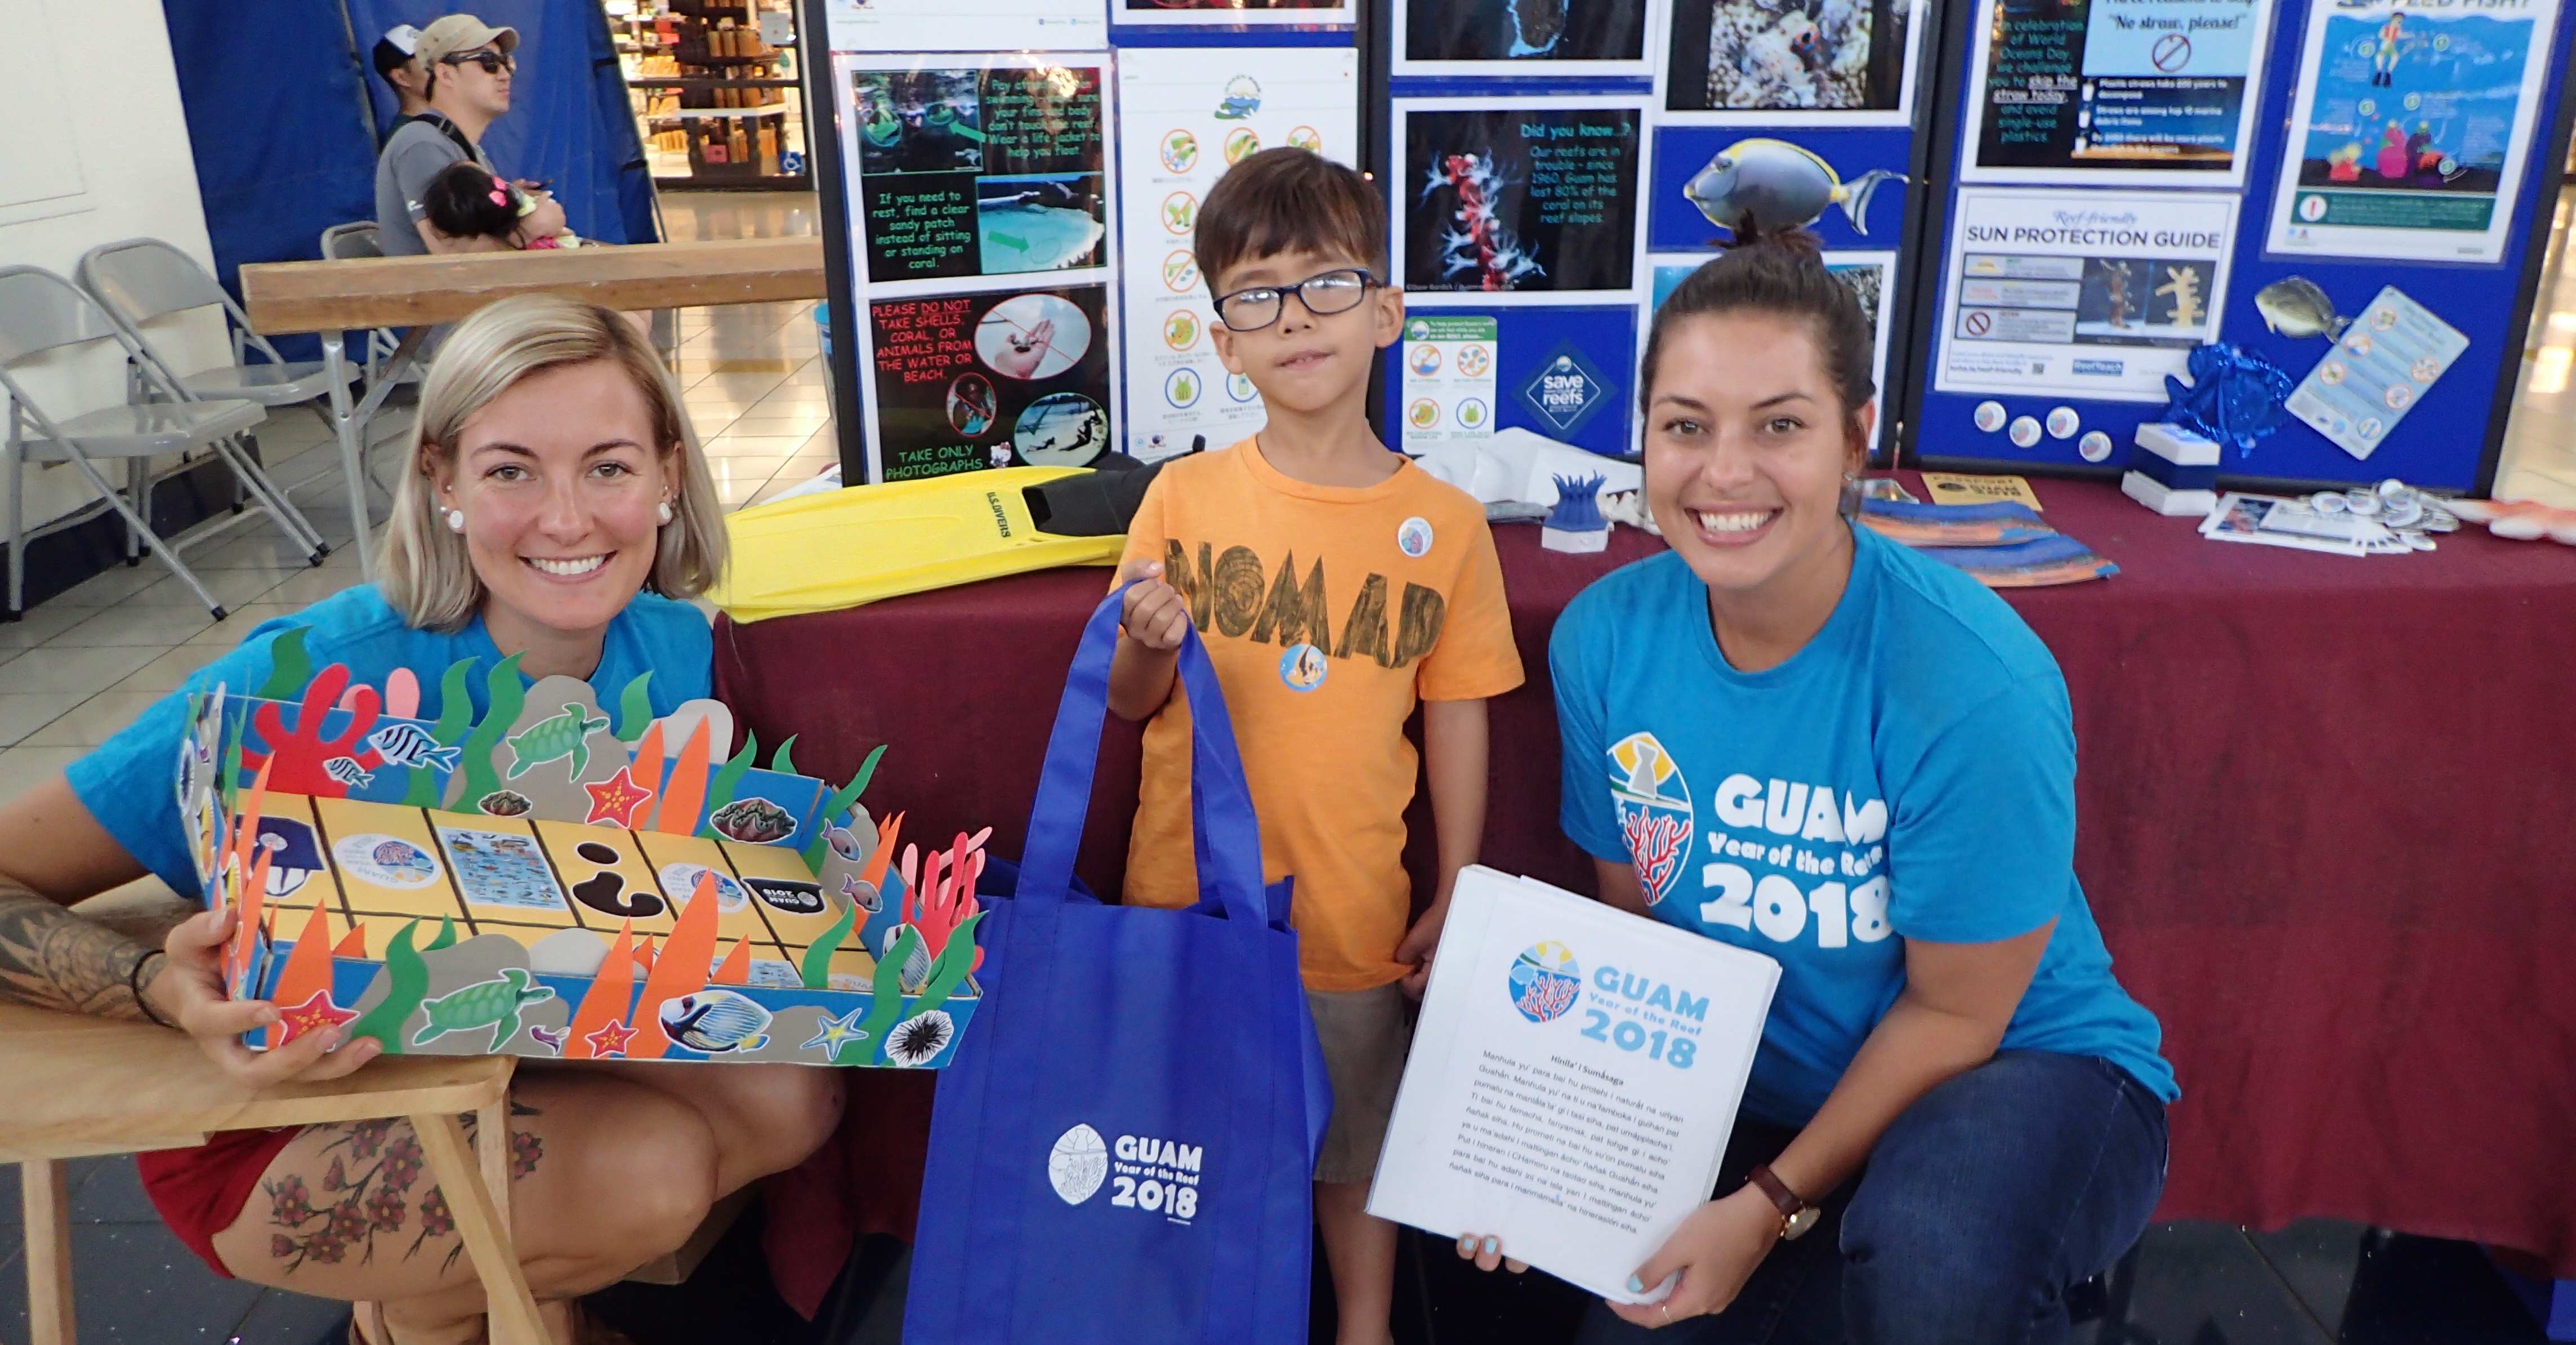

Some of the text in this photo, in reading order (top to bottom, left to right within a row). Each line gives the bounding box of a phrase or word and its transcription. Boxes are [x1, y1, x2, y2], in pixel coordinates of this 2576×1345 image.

[1521, 123, 1545, 137] Did
[1550, 127, 1574, 140] you
[1530, 144, 1620, 157] Our reefs are in
[879, 191, 961, 206] If you need to
[1530, 185, 1551, 197] lost
[1582, 184, 1595, 197] of
[1598, 185, 1617, 197] the
[905, 204, 927, 216] find
[942, 204, 970, 214] clear
[1543, 199, 1604, 210] coral on its
[890, 217, 955, 232] sandy patch
[876, 230, 971, 244] instead of sitting
[1967, 225, 2220, 249] SUN PROTECTION GUIDE
[901, 244, 947, 257] standing
[908, 257, 939, 269] coral.
[873, 300, 971, 317] PLEASE DO NOT
[879, 317, 910, 330] TAKE
[939, 327, 956, 339] OR
[877, 340, 972, 358] ANIMALS FROM
[877, 353, 972, 371] THE WATER OR
[903, 368, 947, 382] BEACH.
[1544, 375, 1583, 389] save
[1543, 388, 1583, 405] reefs
[899, 444, 974, 463] TAKE ONLY
[1165, 538, 1445, 669] NOMAD
[1715, 773, 1889, 846] GUAM
[1708, 831, 1765, 861] Year
[1769, 844, 1792, 867] of
[1796, 850, 1835, 875] the
[1700, 862, 1894, 948] 2018
[1594, 966, 1709, 1022] GUAM
[1589, 992, 1702, 1036] Year of the Reef
[1581, 1008, 1697, 1070] 2018
[1115, 1135, 1203, 1172] GUAM
[1114, 1161, 1199, 1186] Year of the Reef
[1111, 1176, 1198, 1218] 2018
